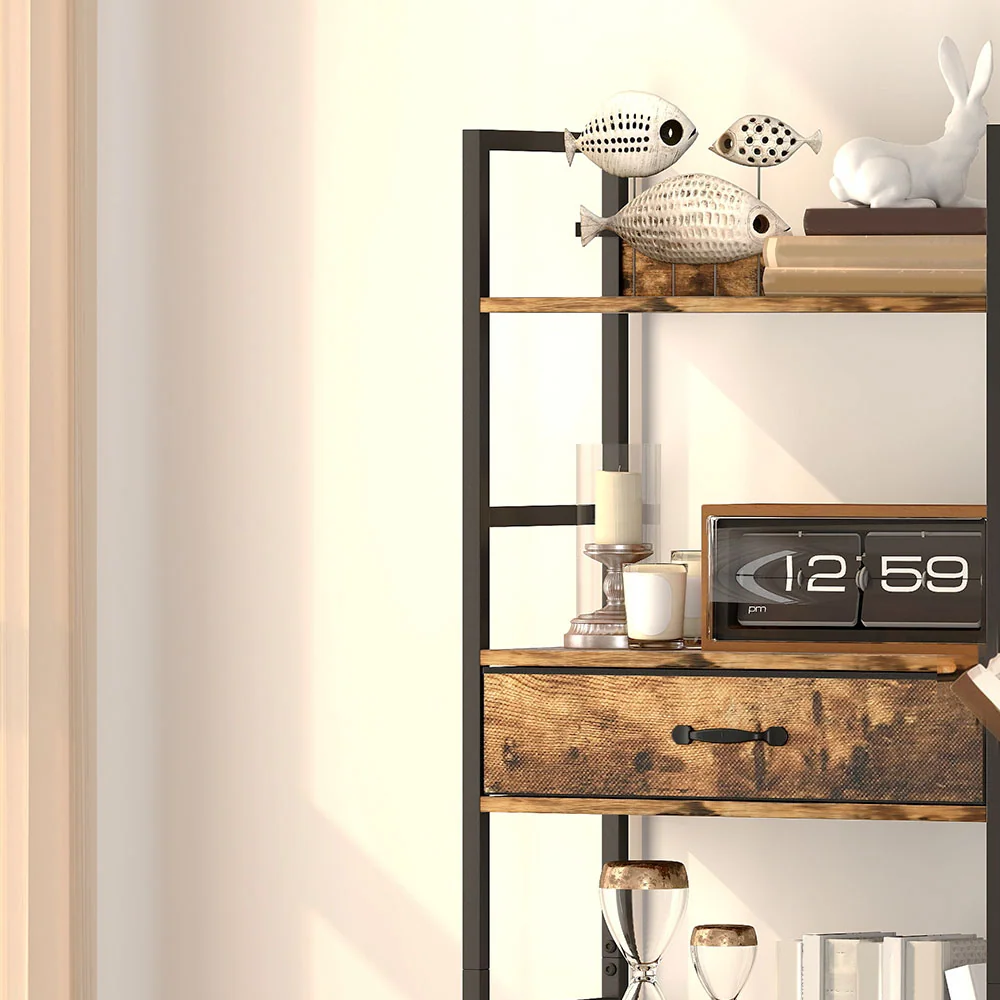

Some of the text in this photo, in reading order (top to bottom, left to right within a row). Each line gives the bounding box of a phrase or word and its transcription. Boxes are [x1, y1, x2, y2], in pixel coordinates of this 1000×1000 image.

[785, 554, 969, 593] 12 59
[747, 605, 767, 614] pm
